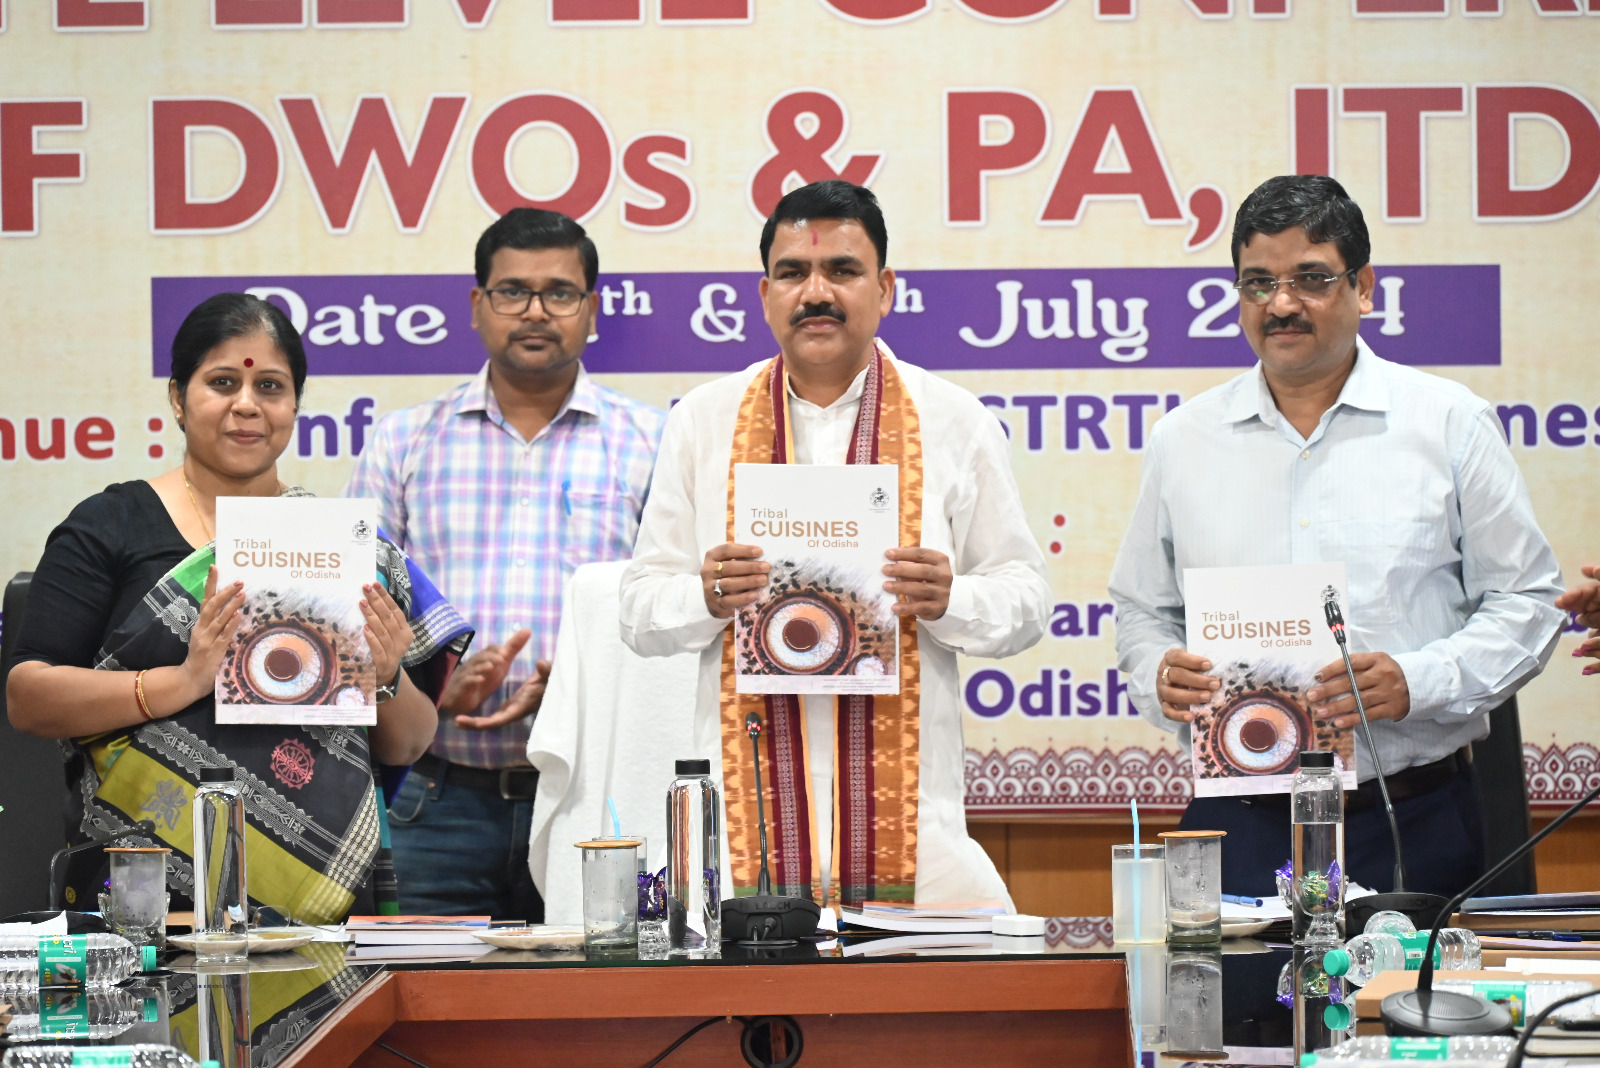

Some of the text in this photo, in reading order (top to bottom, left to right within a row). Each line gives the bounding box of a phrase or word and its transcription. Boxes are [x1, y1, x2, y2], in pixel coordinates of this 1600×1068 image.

[152, 93, 693, 231] DWOs
[751, 91, 880, 218] &
[947, 89, 1223, 247] PA,
[690, 282, 747, 343] &
[958, 278, 1150, 362] July
[1187, 277, 1405, 337] 24
[751, 508, 788, 519] Tribal
[750, 520, 859, 538] CUISINES
[234, 539, 272, 549] Tribal
[807, 539, 859, 548] Of Odisha
[233, 551, 341, 569] CUISINES
[290, 570, 341, 579] Of Odisha
[1202, 611, 1240, 622] Tribal
[1202, 619, 1312, 641] CUISINES
[1260, 638, 1312, 648] Of Odisha
[965, 669, 1140, 718] Odish
